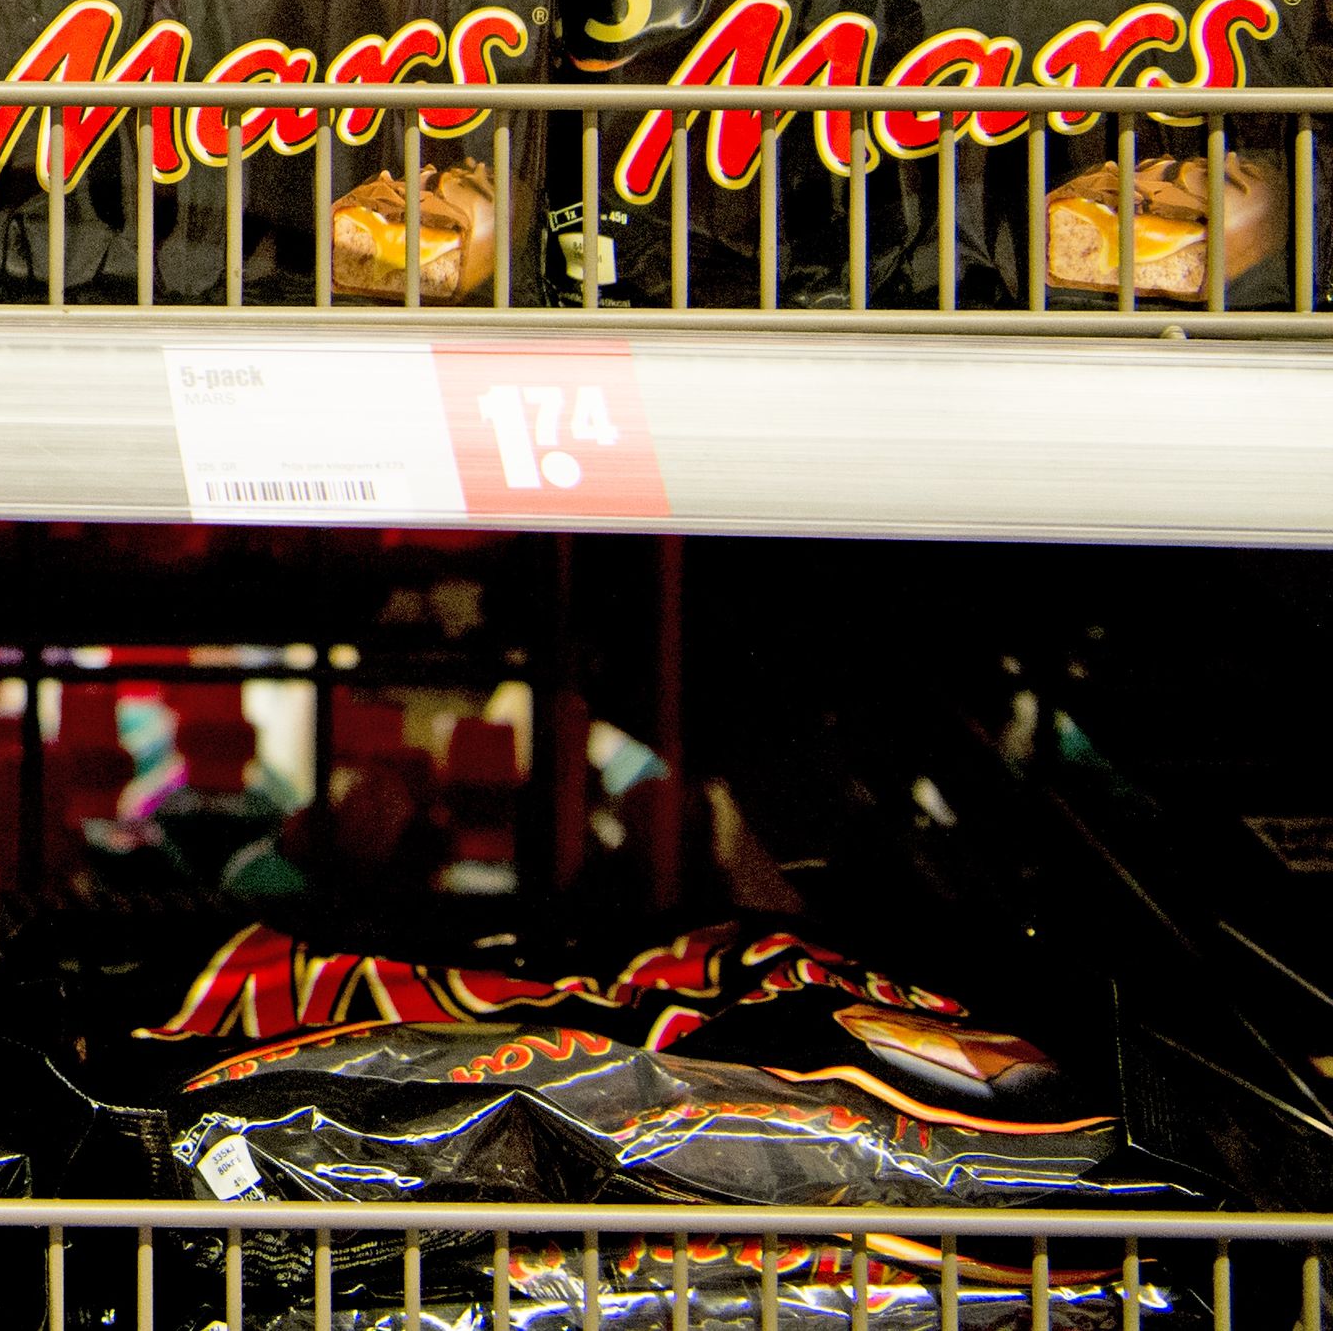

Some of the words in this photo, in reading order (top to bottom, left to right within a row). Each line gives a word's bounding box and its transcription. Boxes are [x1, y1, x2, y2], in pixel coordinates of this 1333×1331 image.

[180, 365, 264, 389] 5-pack
[184, 392, 237, 406] MARS
[476, 384, 619, 490] 1.74
